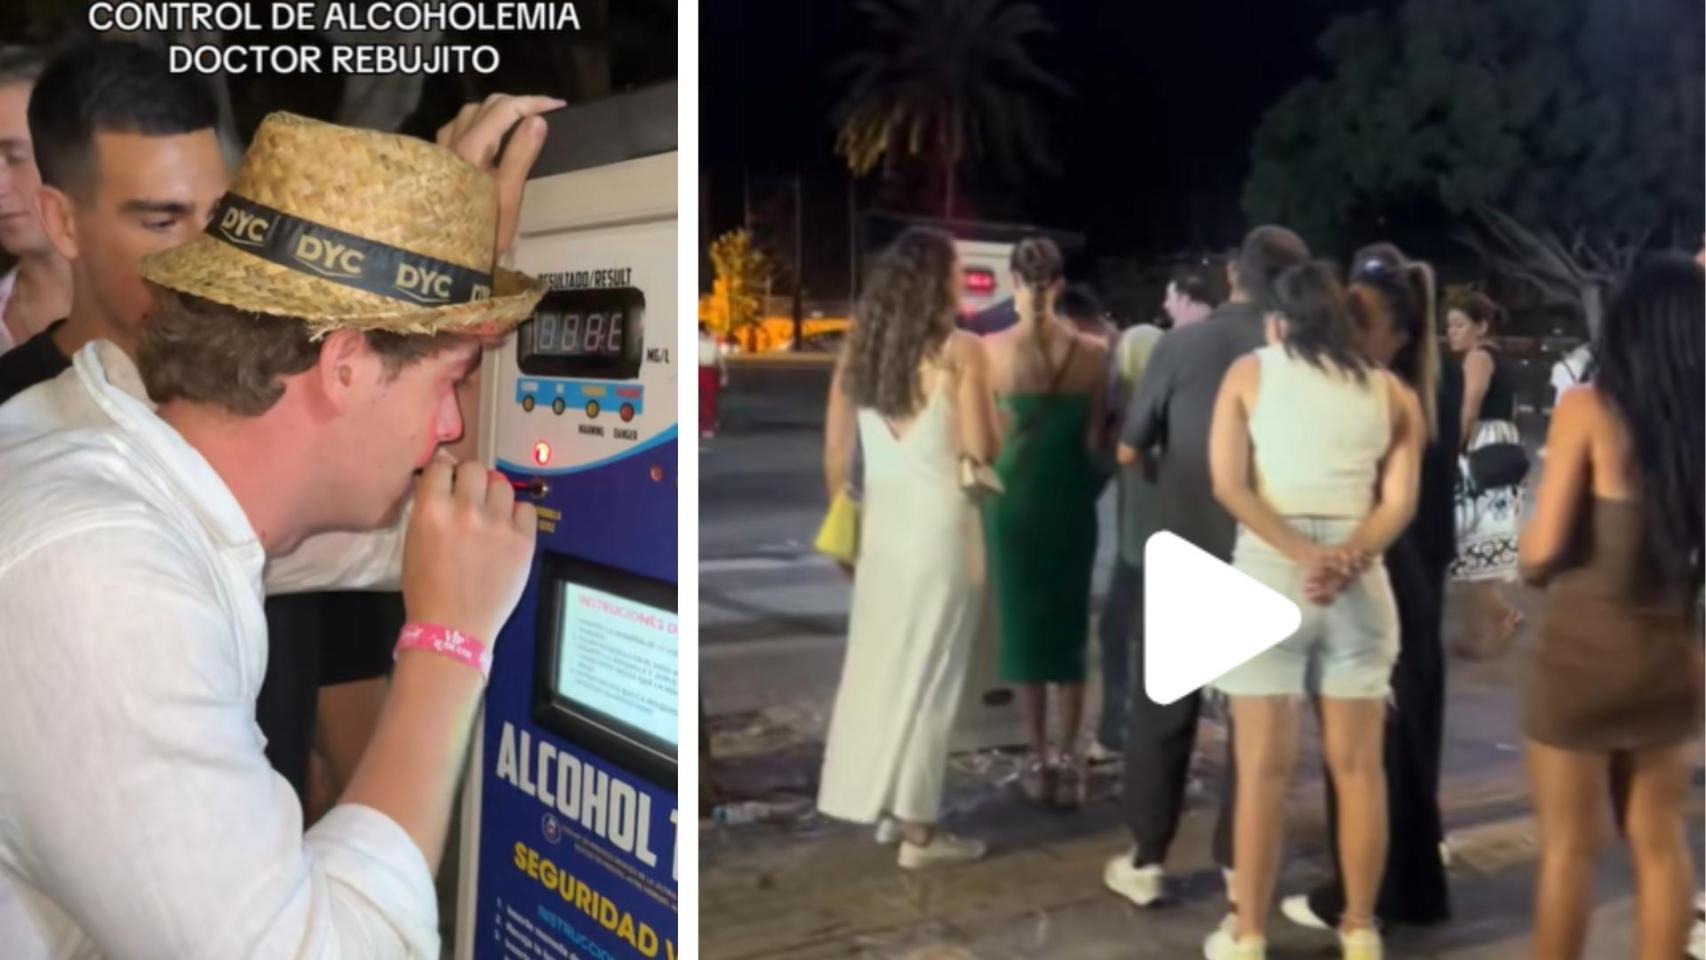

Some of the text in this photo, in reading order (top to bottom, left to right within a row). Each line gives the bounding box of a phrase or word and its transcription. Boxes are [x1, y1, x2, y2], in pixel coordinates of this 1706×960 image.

[221, 207, 269, 243] DYC
[296, 235, 365, 275] DYC
[395, 264, 453, 298] DYC
[496, 720, 658, 868] ALCOHOL
[513, 841, 659, 958] SEGURIDAD
